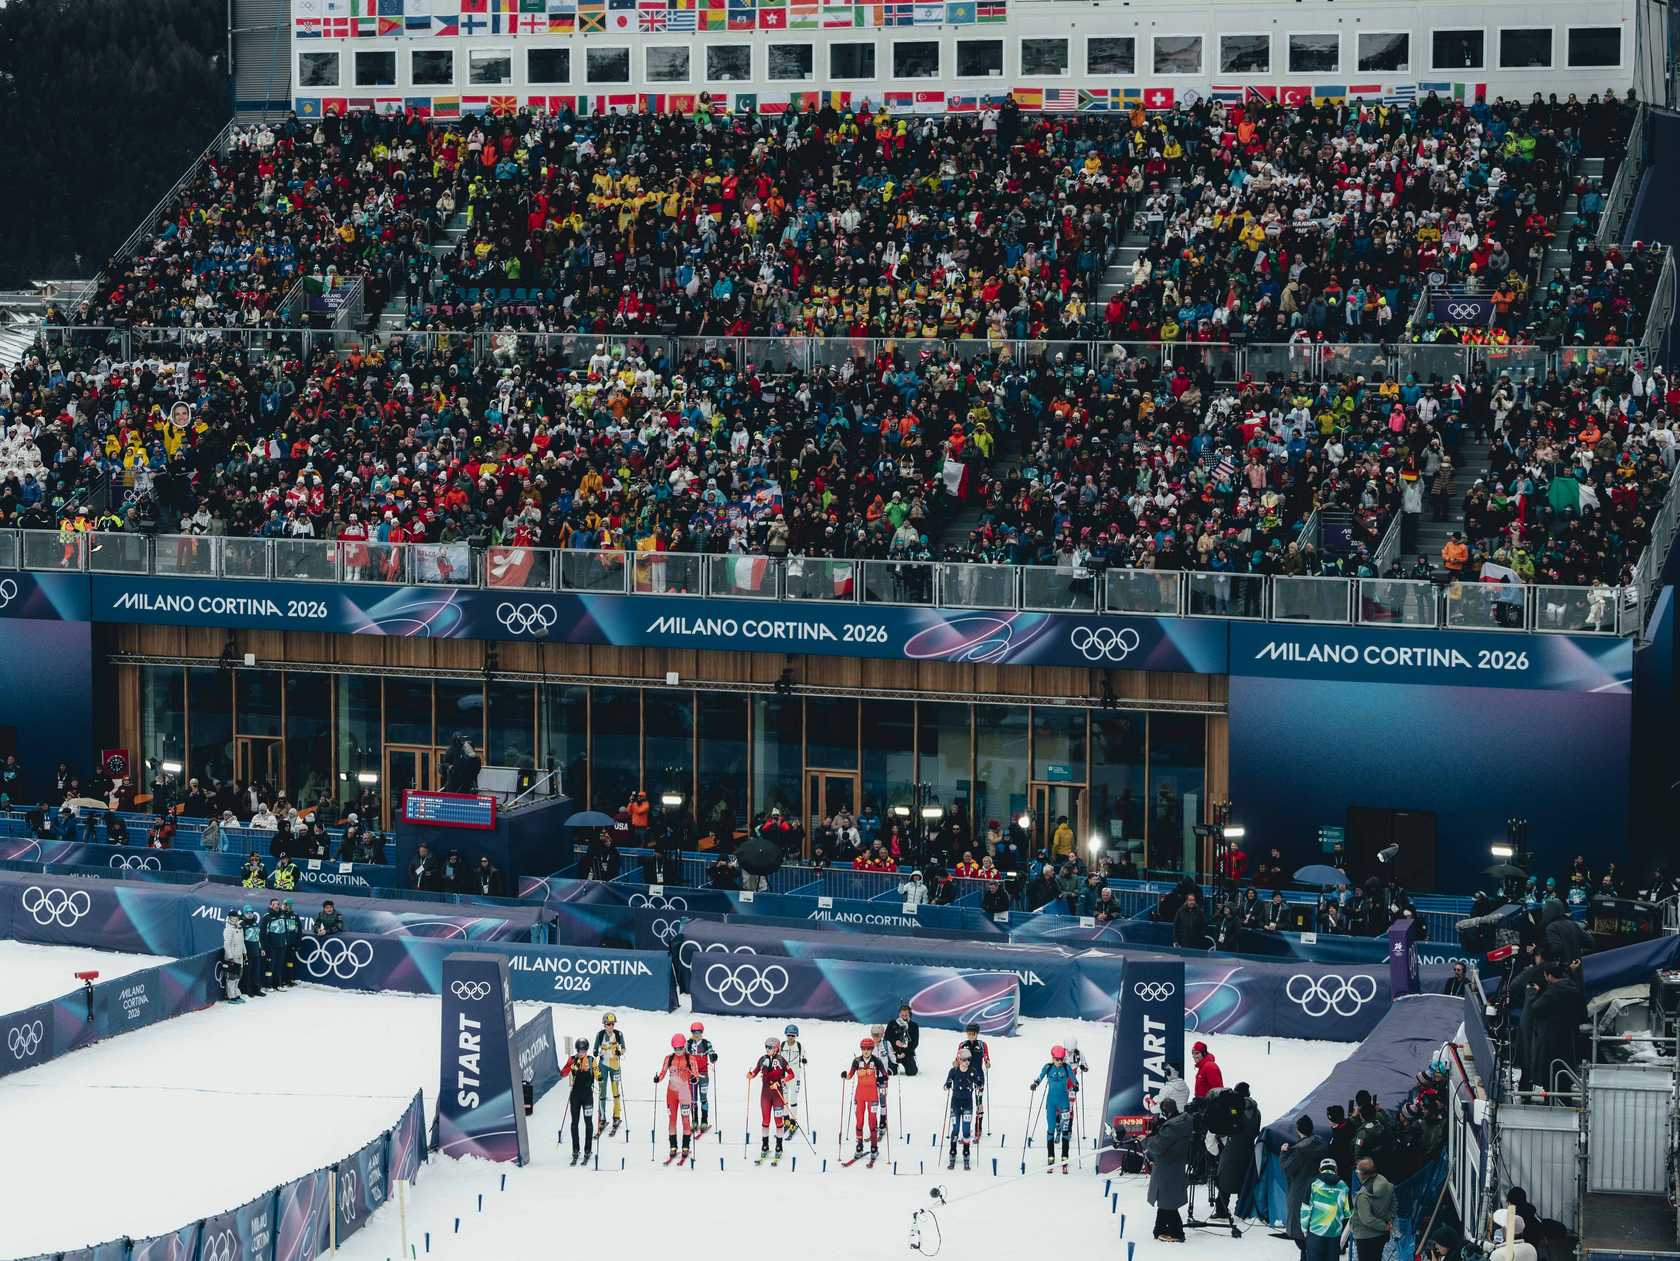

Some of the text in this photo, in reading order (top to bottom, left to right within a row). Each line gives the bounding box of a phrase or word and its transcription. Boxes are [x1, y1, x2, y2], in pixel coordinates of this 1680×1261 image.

[113, 592, 328, 618] MILANO CORTINA 2026
[646, 616, 888, 643] MILANO CORTINA 2026
[1255, 641, 1529, 670] MILANO CORTINA 2026
[614, 822, 629, 831] USA
[319, 872, 370, 887] CORTINA
[807, 909, 922, 928] MILANO CORTINA
[508, 955, 653, 976] MILANO CORTINA
[118, 983, 145, 1000] MILANO
[554, 975, 591, 992] 2026
[123, 994, 149, 1010] CORTINA
[457, 1012, 481, 1109] START
